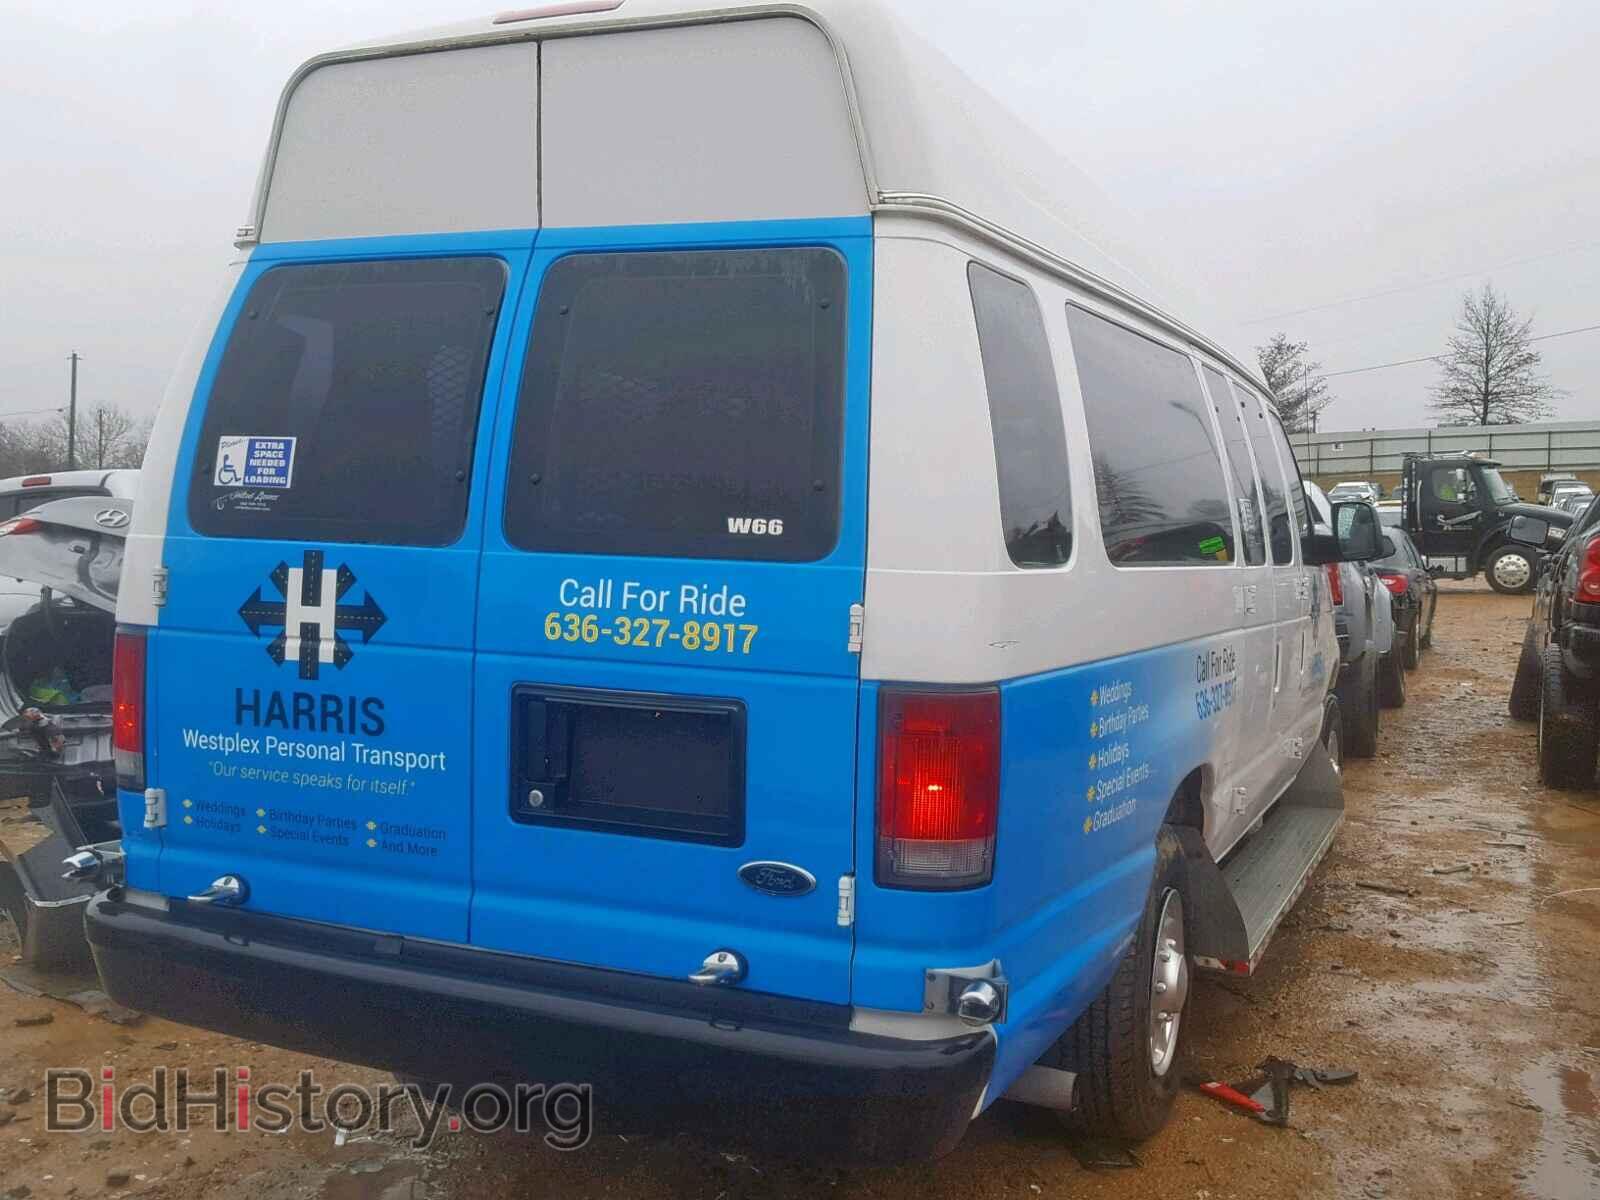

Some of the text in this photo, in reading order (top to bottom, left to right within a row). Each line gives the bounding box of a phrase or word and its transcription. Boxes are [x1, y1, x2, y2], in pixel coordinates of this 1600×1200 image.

[254, 450, 284, 458] SPACE
[255, 441, 285, 450] EXTRA
[249, 458, 286, 467] NEEDED
[257, 467, 276, 475] FOR
[244, 475, 286, 484] LOADING
[727, 517, 784, 536] W66
[559, 578, 746, 617] Call For Ride
[544, 612, 759, 654] 636-327-8917
[1196, 651, 1210, 683] Call
[1211, 651, 1222, 679] For
[1100, 679, 1132, 705] Weddings
[234, 687, 385, 737] HARRIS
[1099, 703, 1149, 738] Birthday Parties
[182, 729, 446, 773] Westplex Personal Transport
[1098, 741, 1129, 768] Holidays
[240, 765, 289, 783] service
[293, 771, 342, 789] speaks
[346, 774, 366, 791] for
[1096, 763, 1149, 804] Special Events
[195, 800, 245, 817] Weddings
[269, 807, 357, 831] Birthday Parties
[1093, 799, 1136, 832] Graduation
[196, 815, 241, 833] Holidays
[270, 825, 349, 846] Special Events
[380, 821, 447, 840] Graduation
[381, 840, 438, 857] And More
[755, 867, 794, 889] Ford
